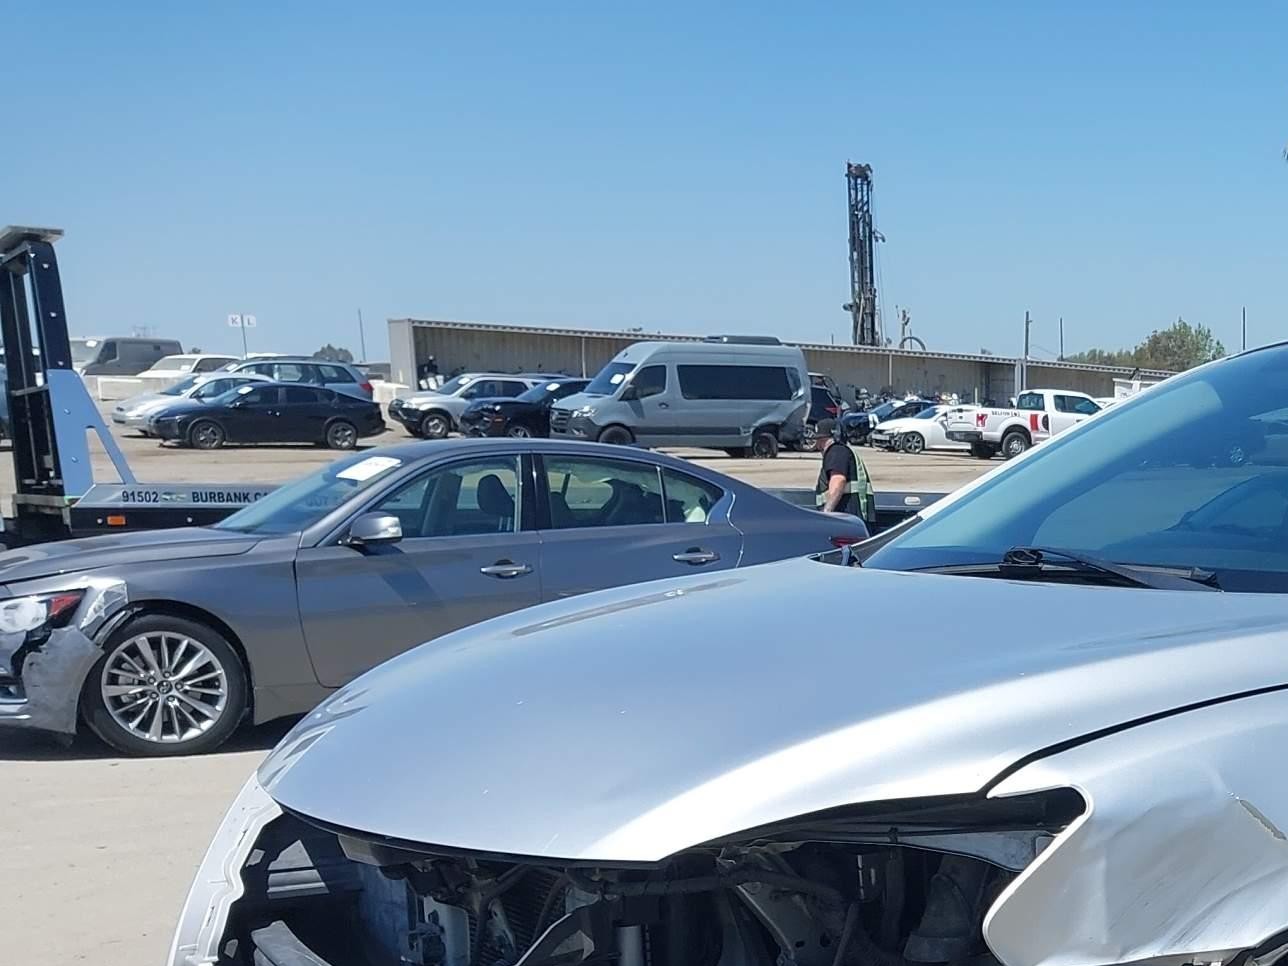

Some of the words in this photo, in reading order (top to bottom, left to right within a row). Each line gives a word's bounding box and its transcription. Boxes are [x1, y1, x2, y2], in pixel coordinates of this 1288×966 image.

[231, 316, 239, 325] K
[247, 317, 255, 326] L
[122, 490, 159, 503] 91502
[192, 491, 251, 503] BURBANK
